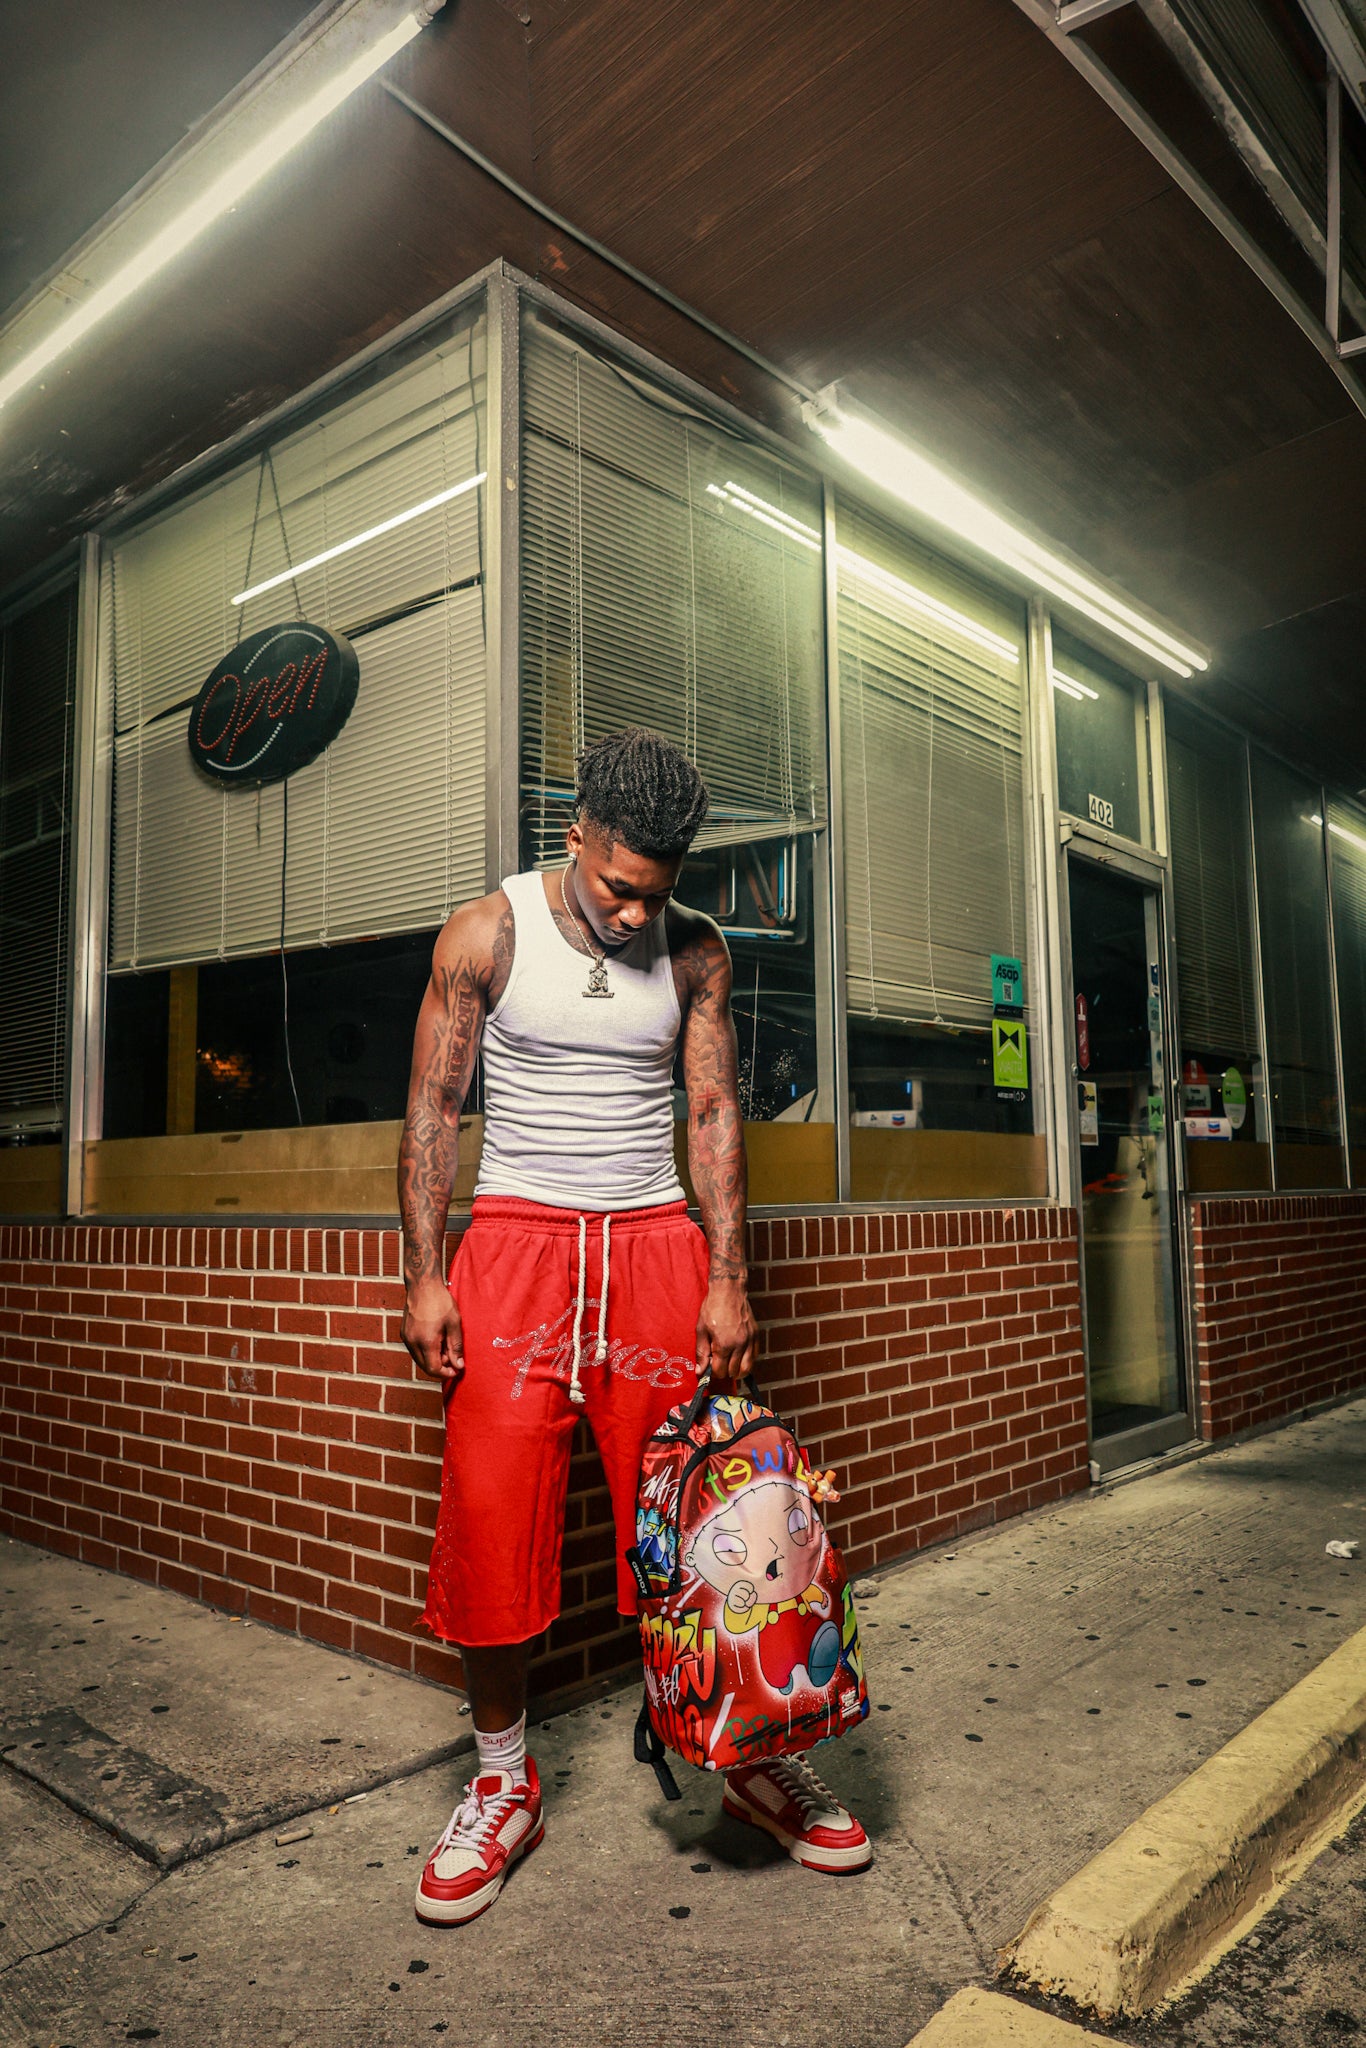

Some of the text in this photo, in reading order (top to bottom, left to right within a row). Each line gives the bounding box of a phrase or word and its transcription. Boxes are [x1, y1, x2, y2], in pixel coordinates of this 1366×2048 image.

[197, 646, 329, 763] Open
[1090, 797, 1112, 826] 402
[995, 963, 1019, 985] Asap
